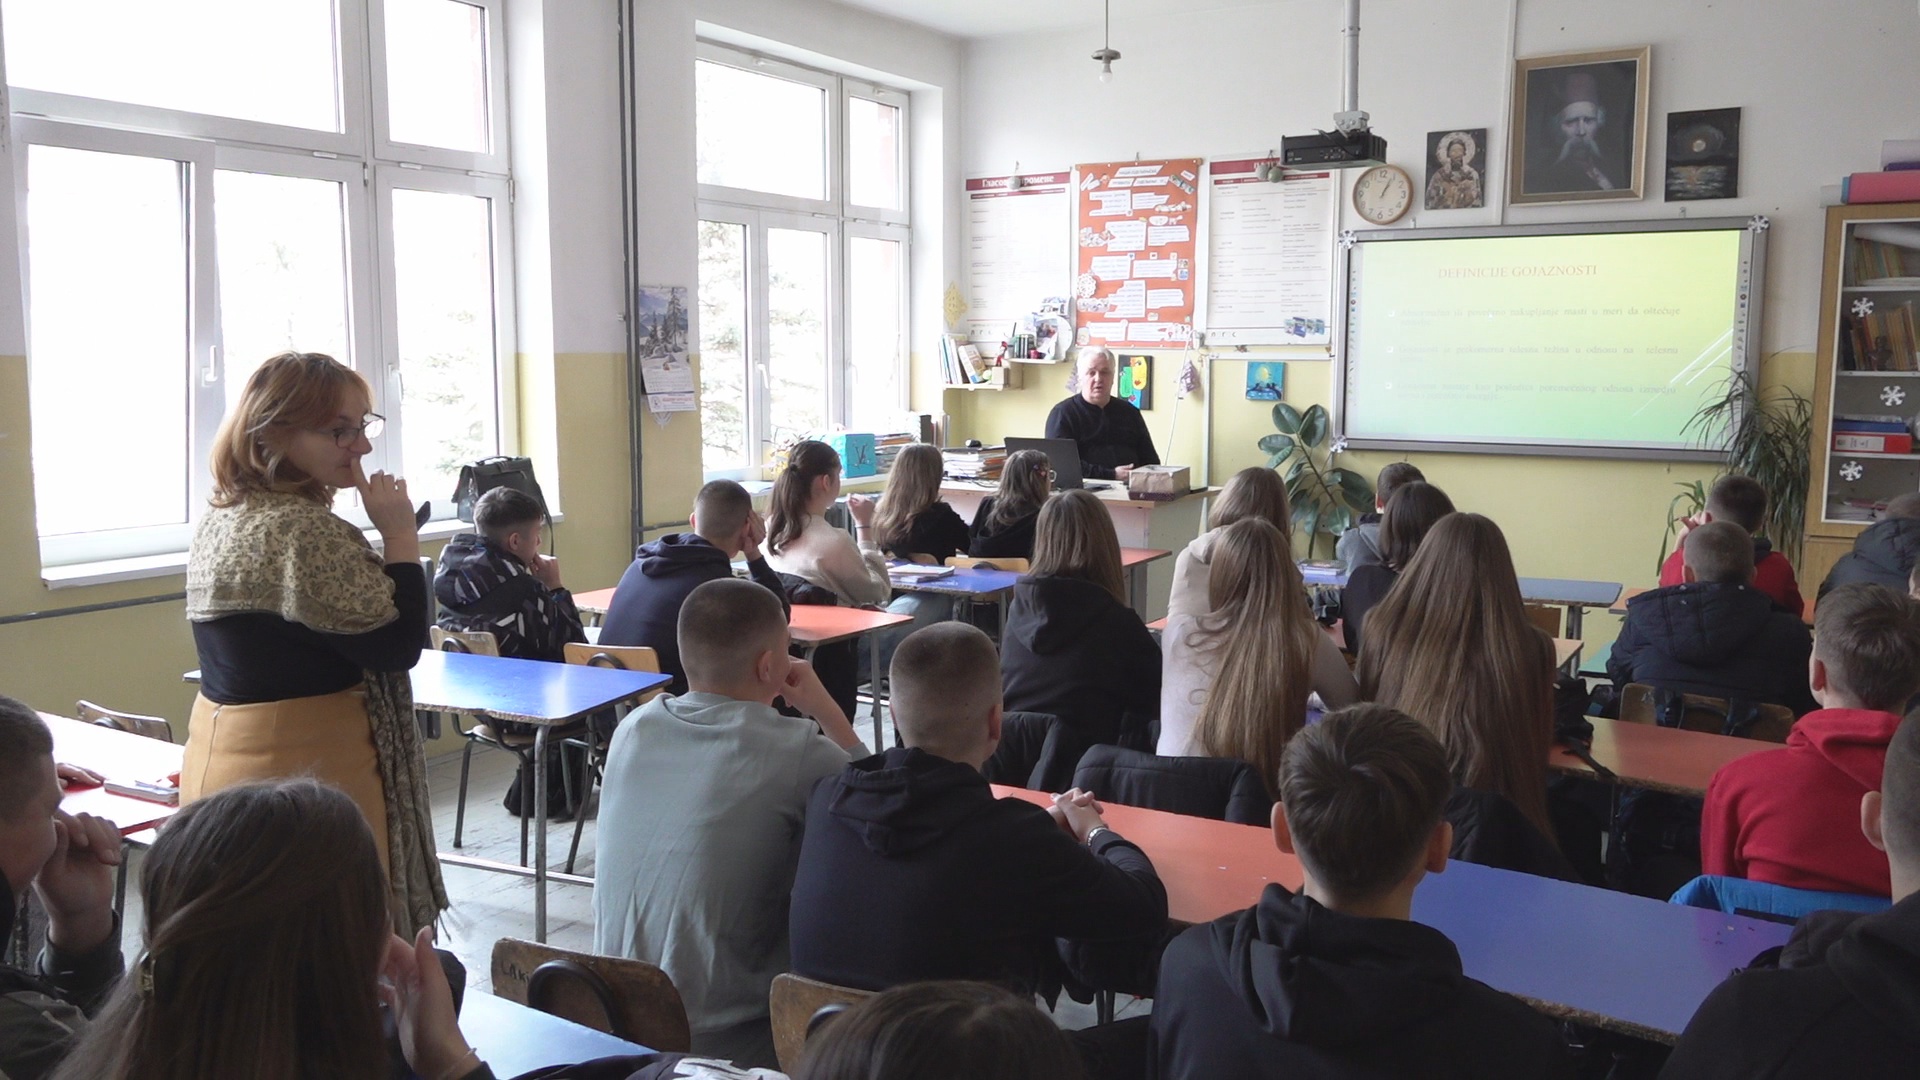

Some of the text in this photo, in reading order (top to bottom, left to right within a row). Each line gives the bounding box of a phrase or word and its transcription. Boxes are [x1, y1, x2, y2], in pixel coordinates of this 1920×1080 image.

[1438, 264, 1598, 279] DEFINICIJE GOJAZNOSTI
[1602, 306, 1623, 316] meri
[1628, 305, 1639, 316] da
[1623, 347, 1634, 355] na
